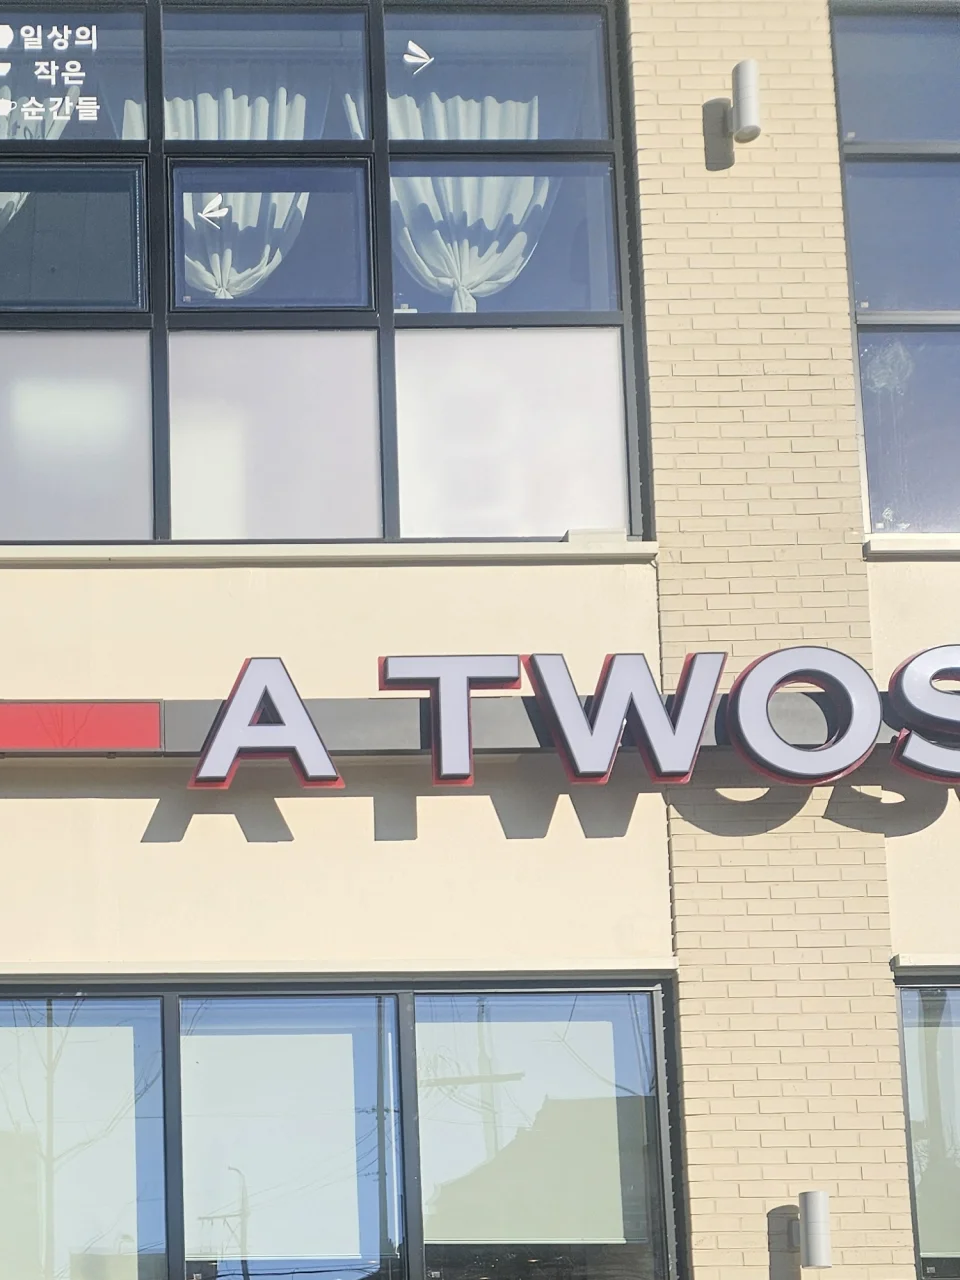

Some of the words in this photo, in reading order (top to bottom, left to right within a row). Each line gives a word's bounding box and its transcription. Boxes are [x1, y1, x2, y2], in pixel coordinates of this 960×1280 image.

[21, 25, 97, 51] 일상의
[35, 60, 86, 86] 작은
[21, 96, 101, 123] 순간들
[188, 655, 344, 789] A
